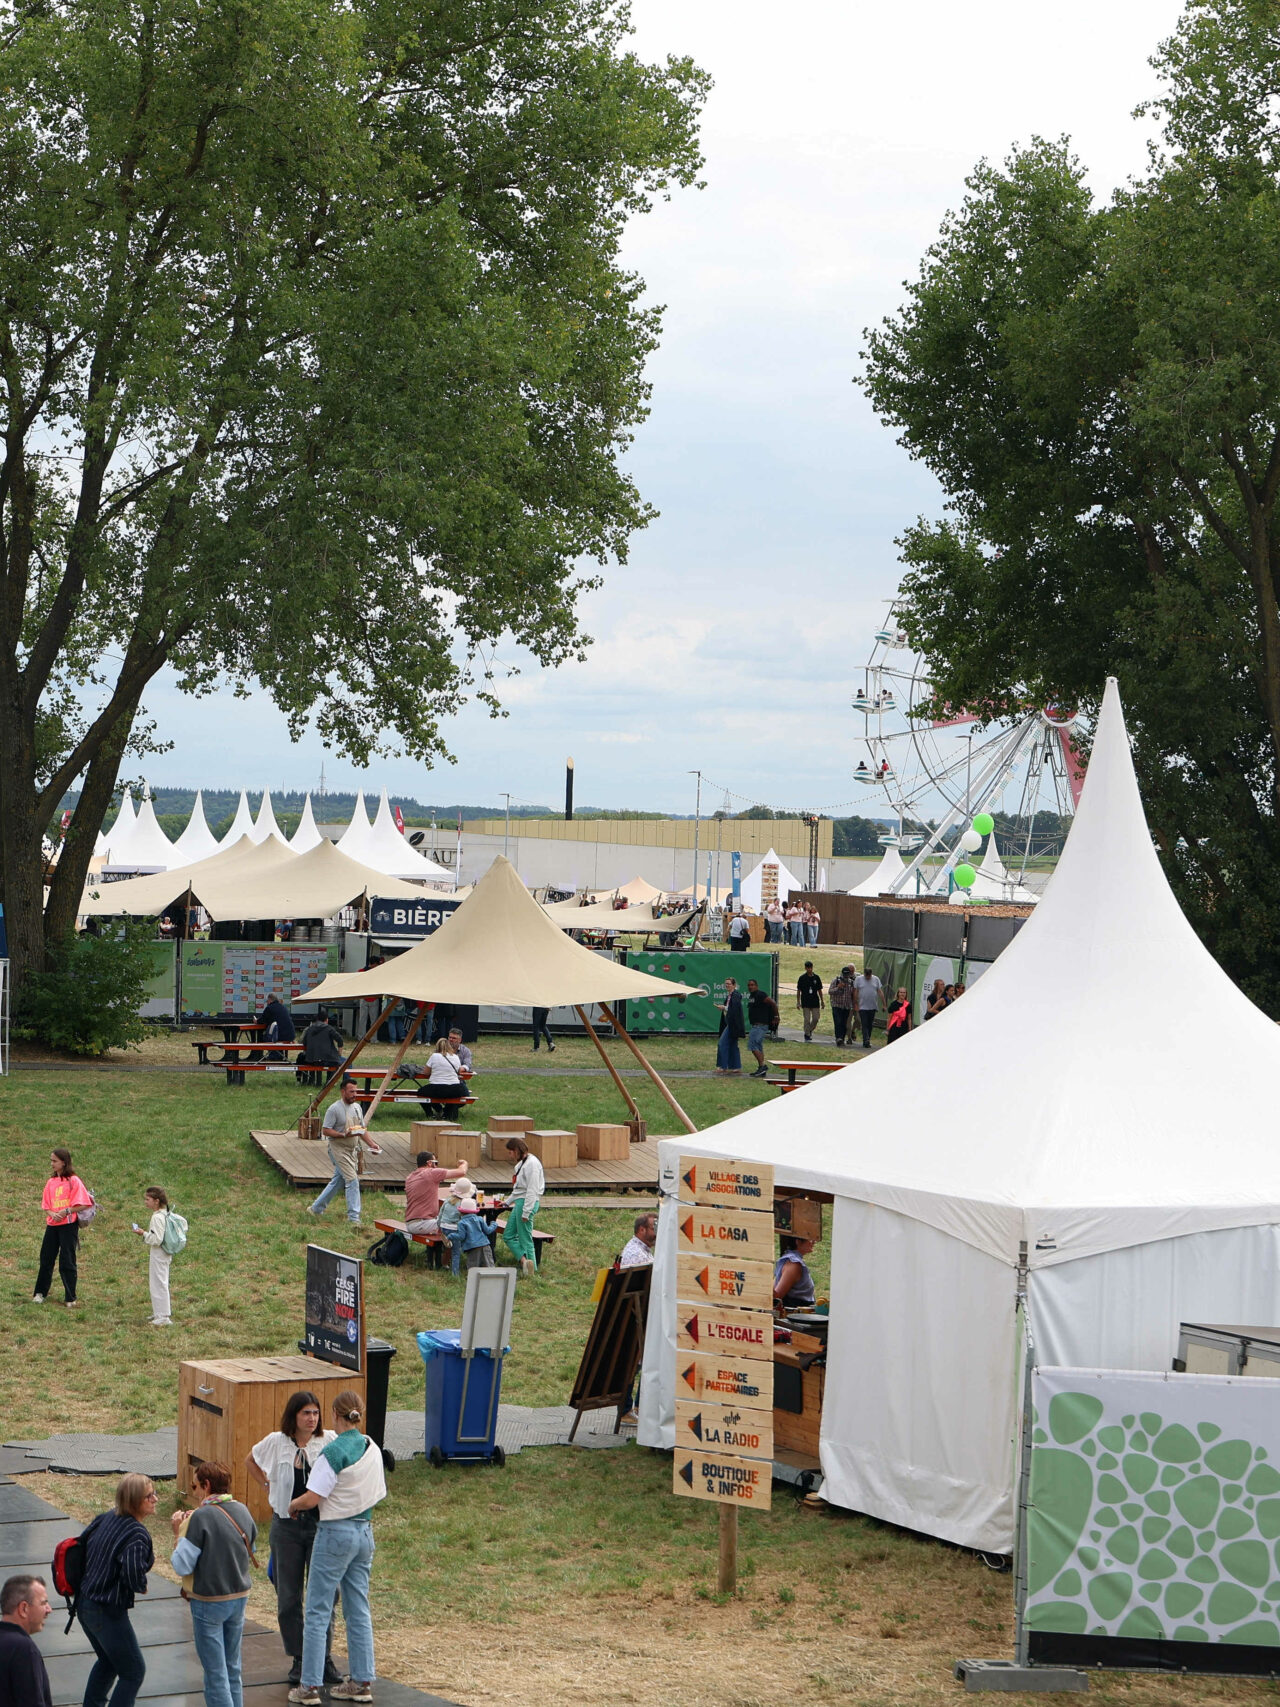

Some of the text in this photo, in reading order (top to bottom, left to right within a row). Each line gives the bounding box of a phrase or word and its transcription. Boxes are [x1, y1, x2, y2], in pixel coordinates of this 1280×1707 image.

[709, 1171, 759, 1185] VILLAGE DES
[706, 1182, 761, 1198] ASSOCIATIONS
[701, 1224, 749, 1242] LA CASA
[335, 1277, 355, 1293] CEASE
[720, 1281, 744, 1297] P&V
[335, 1287, 355, 1307] FIRE
[708, 1323, 764, 1344] L'ESCALE
[717, 1370, 748, 1383] ESPACE
[705, 1380, 760, 1397] PARTENAIRES
[705, 1428, 760, 1449] LA RADIO
[702, 1462, 759, 1485] BOUTIQUE
[707, 1479, 753, 1499] & INFOS
